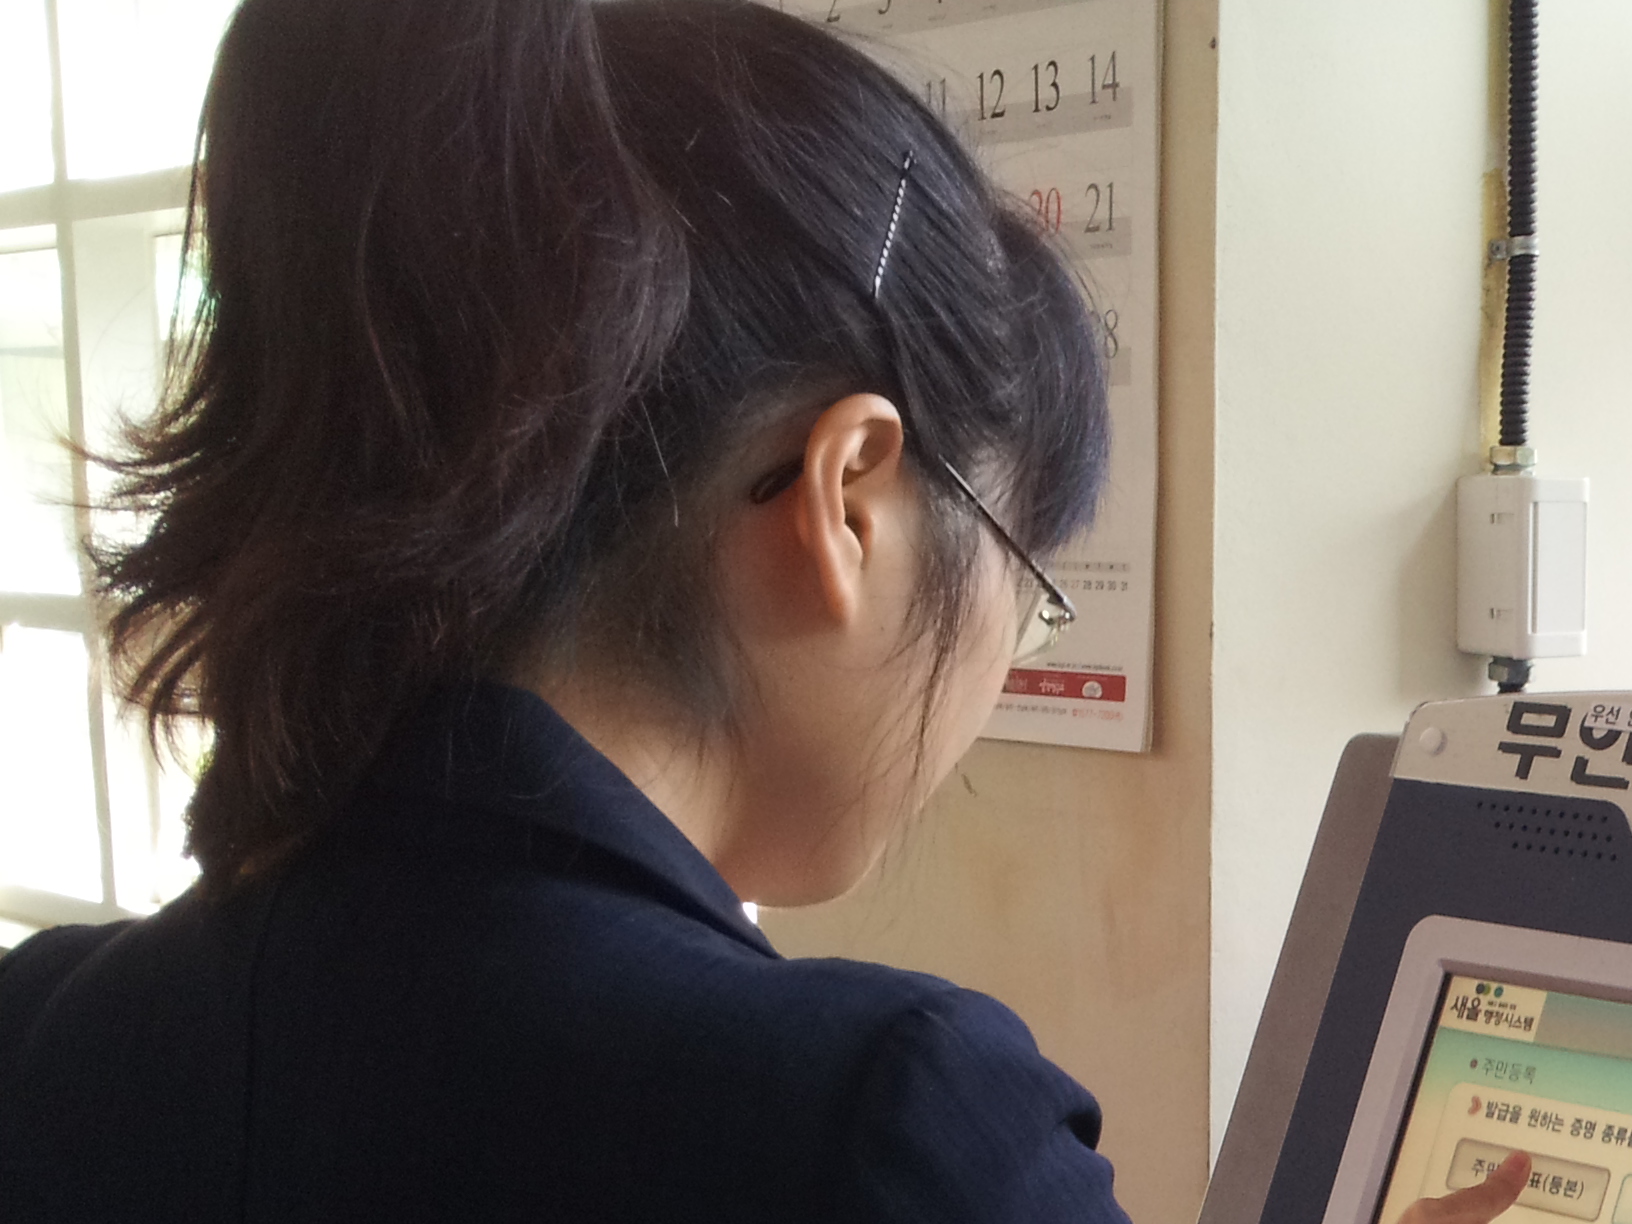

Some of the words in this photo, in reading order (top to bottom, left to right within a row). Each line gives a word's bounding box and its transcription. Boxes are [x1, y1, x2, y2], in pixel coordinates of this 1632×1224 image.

[976, 69, 1006, 121] 12
[1031, 60, 1061, 113] 13
[1088, 50, 1120, 105] 14
[1084, 182, 1116, 235] 21
[1590, 703, 1620, 727] 우선
[1482, 1057, 1538, 1085] 주민등록
[1485, 1100, 1522, 1126] 발급을
[1528, 1109, 1564, 1133] 원하는
[1571, 1116, 1597, 1140] 증명
